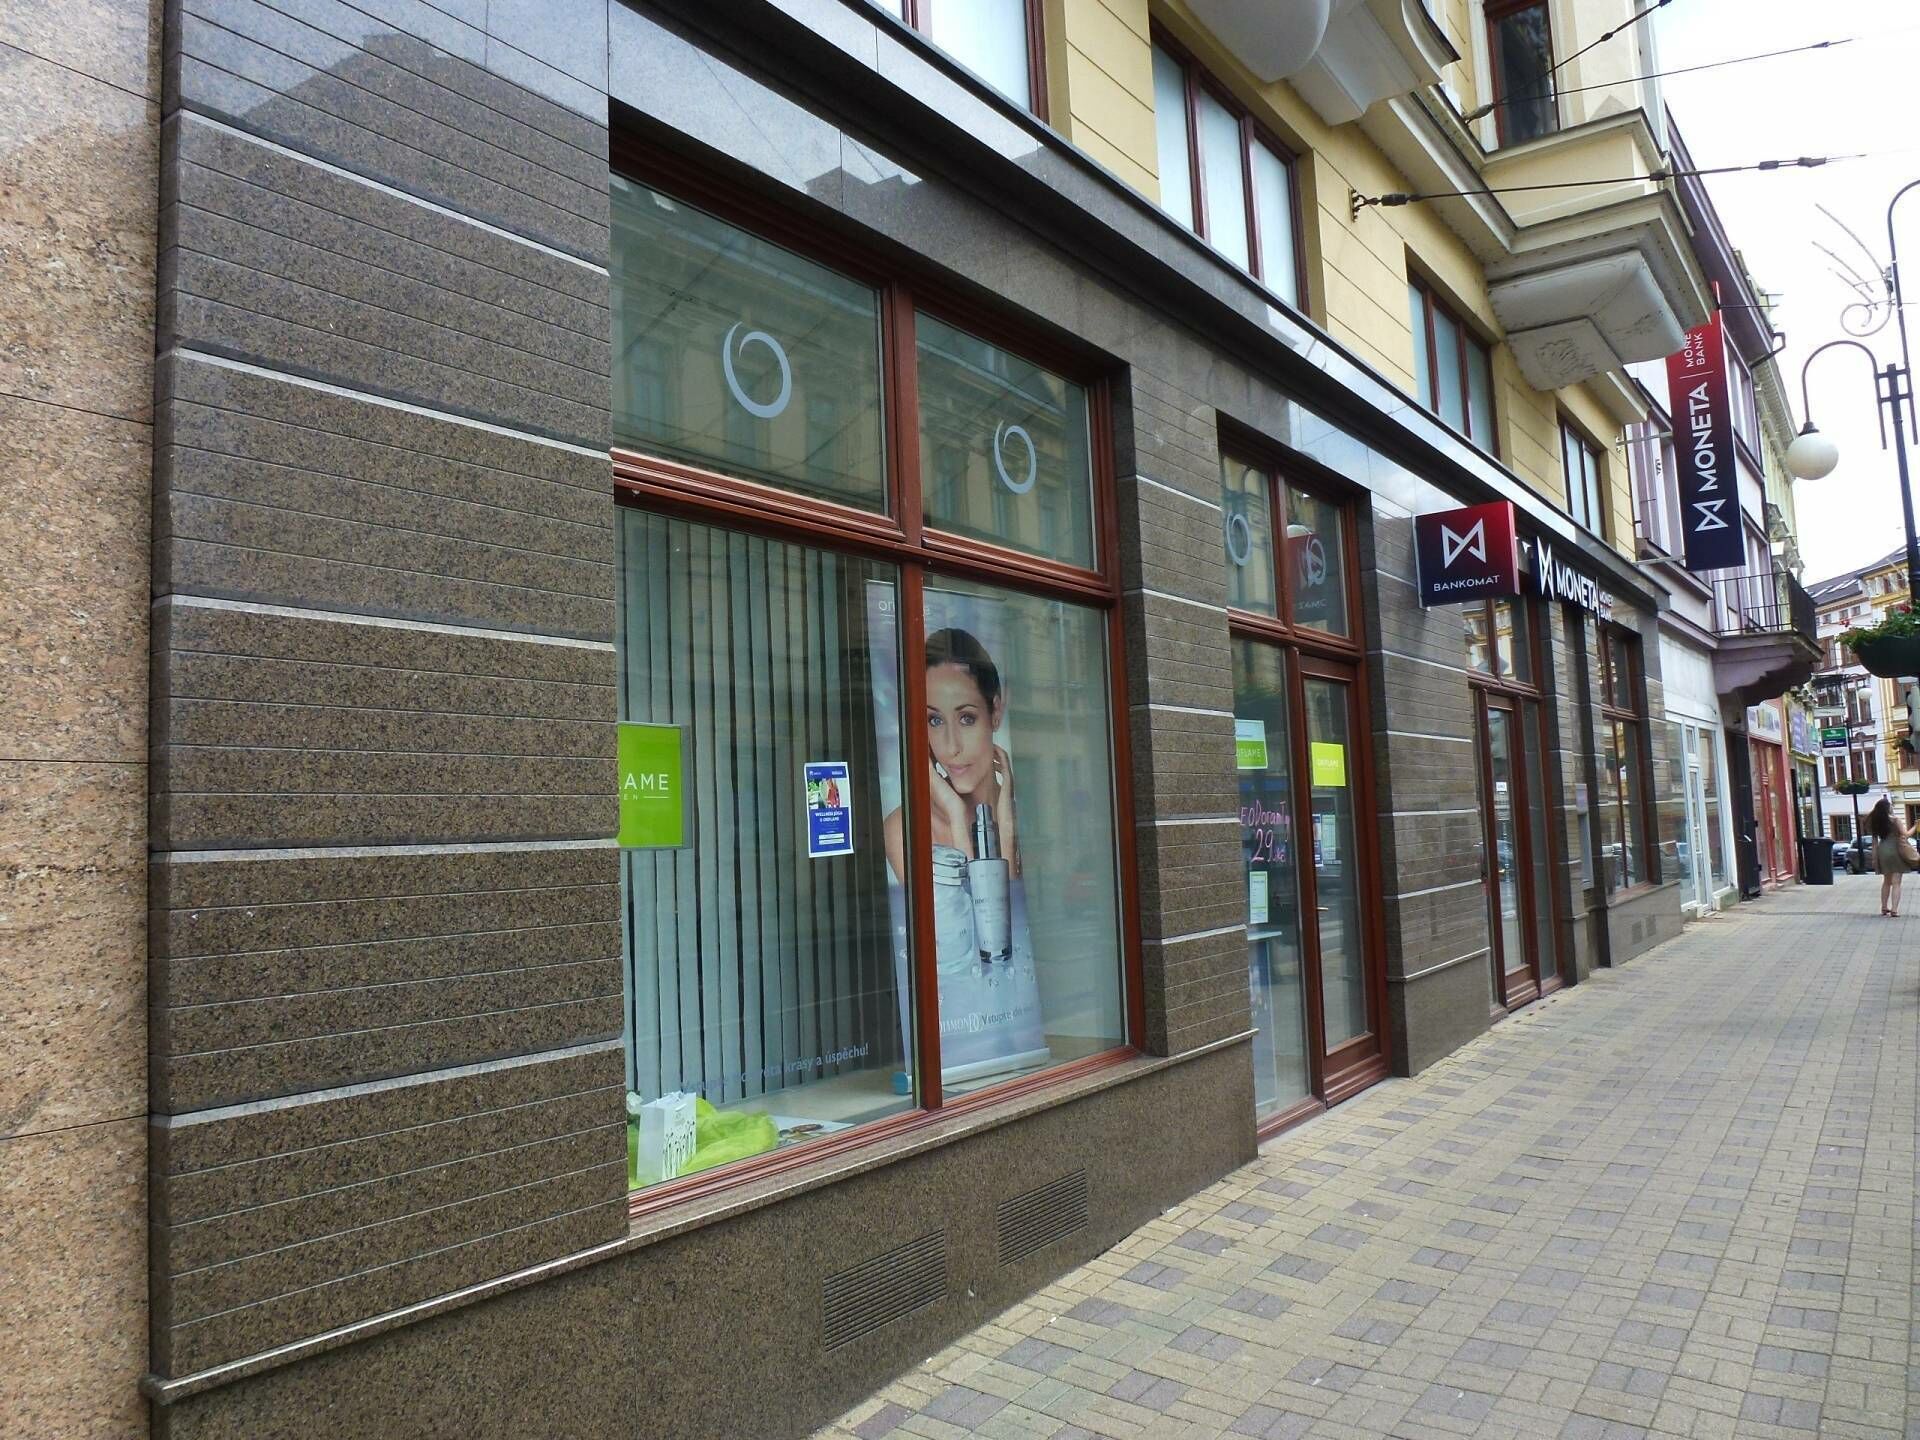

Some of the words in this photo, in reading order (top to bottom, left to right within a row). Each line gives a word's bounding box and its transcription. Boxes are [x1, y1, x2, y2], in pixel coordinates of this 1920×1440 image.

[1684, 333, 1695, 368] MONE
[1694, 332, 1706, 366] BANK
[1688, 381, 1718, 492] MONETA
[1433, 575, 1500, 592] BANKOMAT
[1555, 560, 1599, 612] MONETA
[619, 773, 669, 791] AME
[784, 1055, 814, 1073] krásy
[816, 1056, 823, 1066] a
[825, 1042, 869, 1065] úspěchu!
